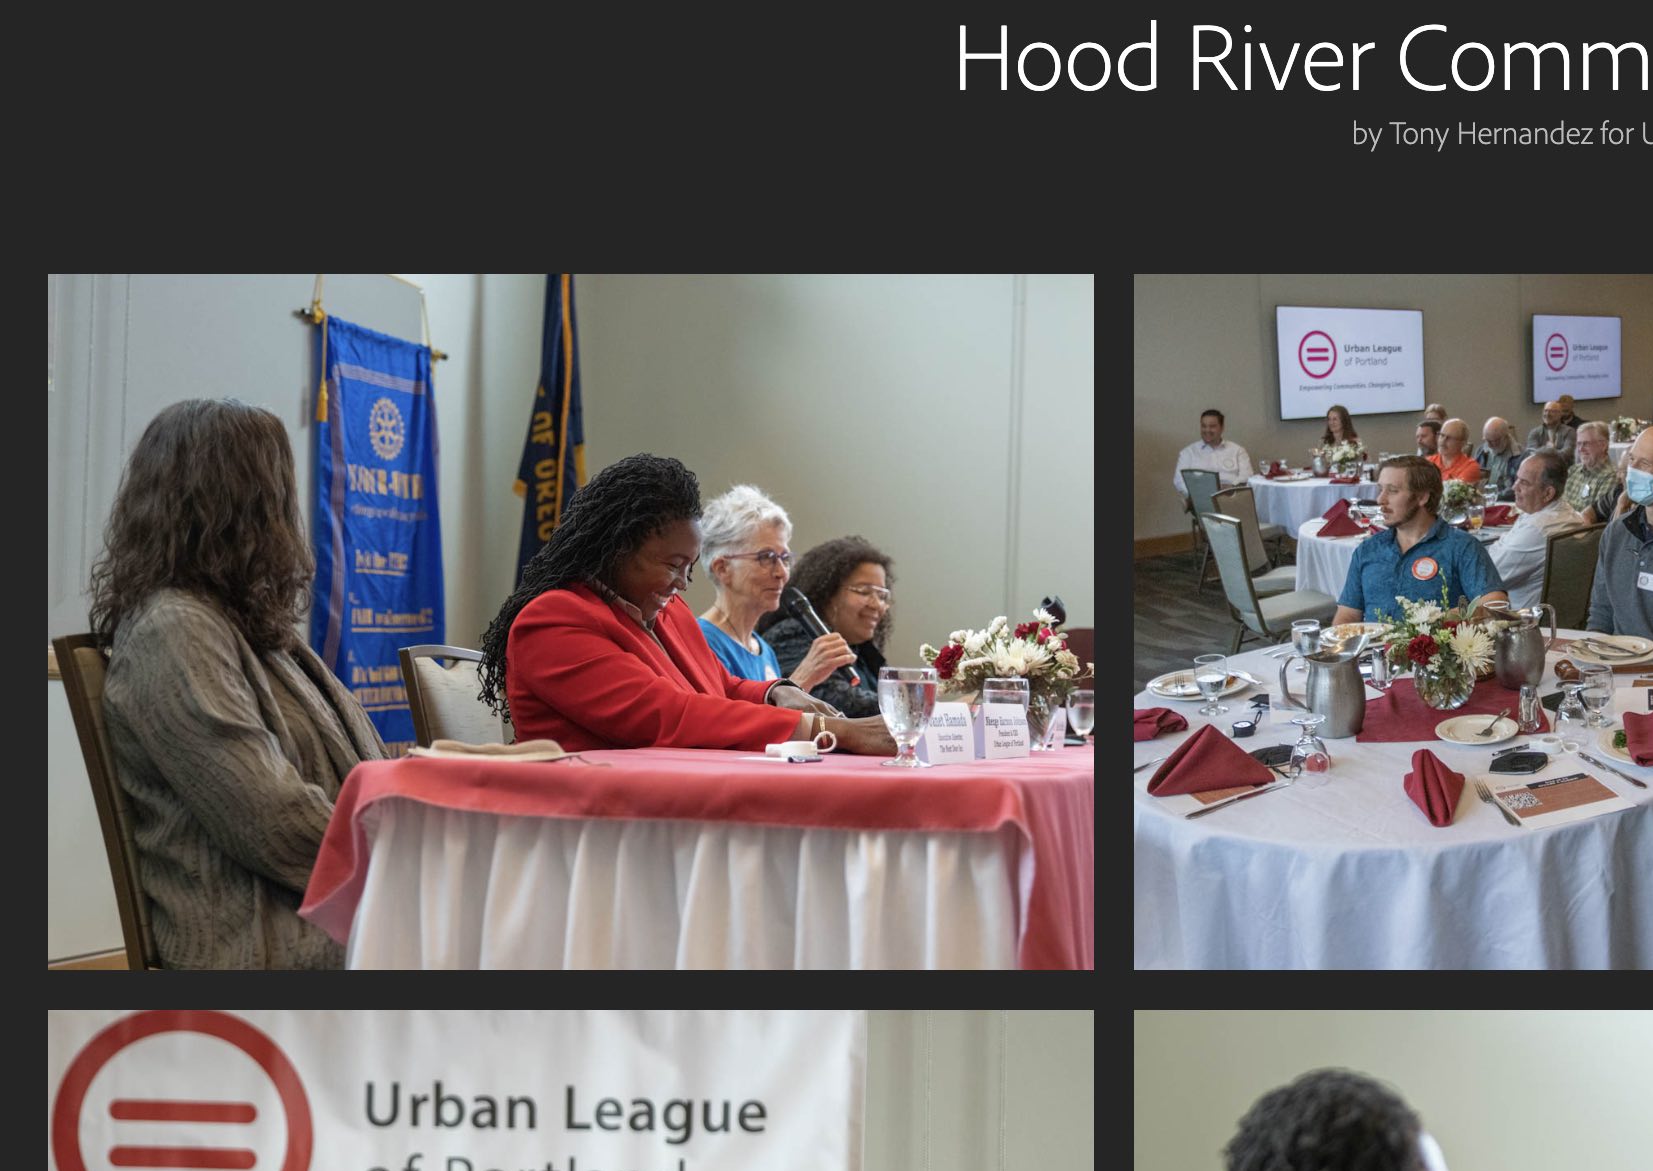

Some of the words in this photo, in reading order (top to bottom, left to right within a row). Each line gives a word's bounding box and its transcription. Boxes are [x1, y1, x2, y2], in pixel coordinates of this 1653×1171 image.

[1344, 344, 1371, 353] Urban
[1372, 345, 1402, 354] League
[1344, 357, 1353, 366] of
[1355, 357, 1388, 366] Portland
[364, 1081, 537, 1131] Urban
[565, 1085, 768, 1145] League
